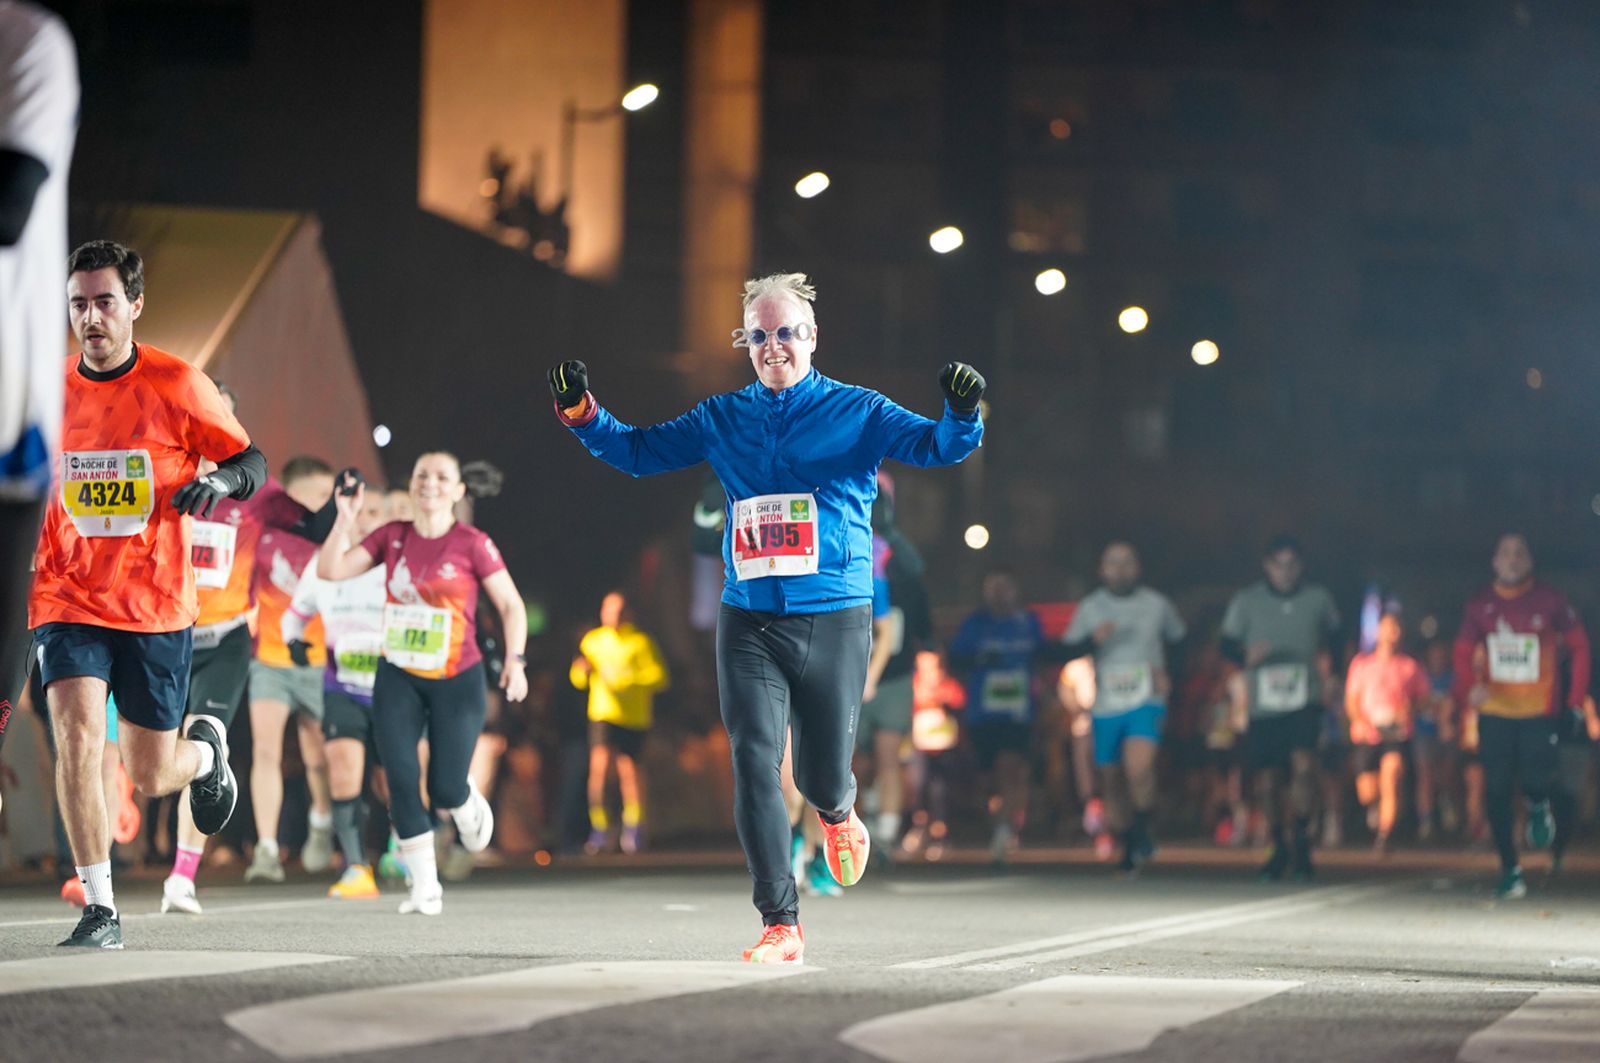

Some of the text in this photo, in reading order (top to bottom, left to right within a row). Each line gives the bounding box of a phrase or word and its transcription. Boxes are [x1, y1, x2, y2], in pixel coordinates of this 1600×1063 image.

[80, 461, 105, 470] NOCHE
[107, 460, 118, 469] DE
[71, 471, 89, 480] SAN
[89, 469, 119, 480] ANTÓN
[78, 481, 137, 507] 4324
[771, 503, 782, 513] DE
[756, 512, 783, 523] NTÓN
